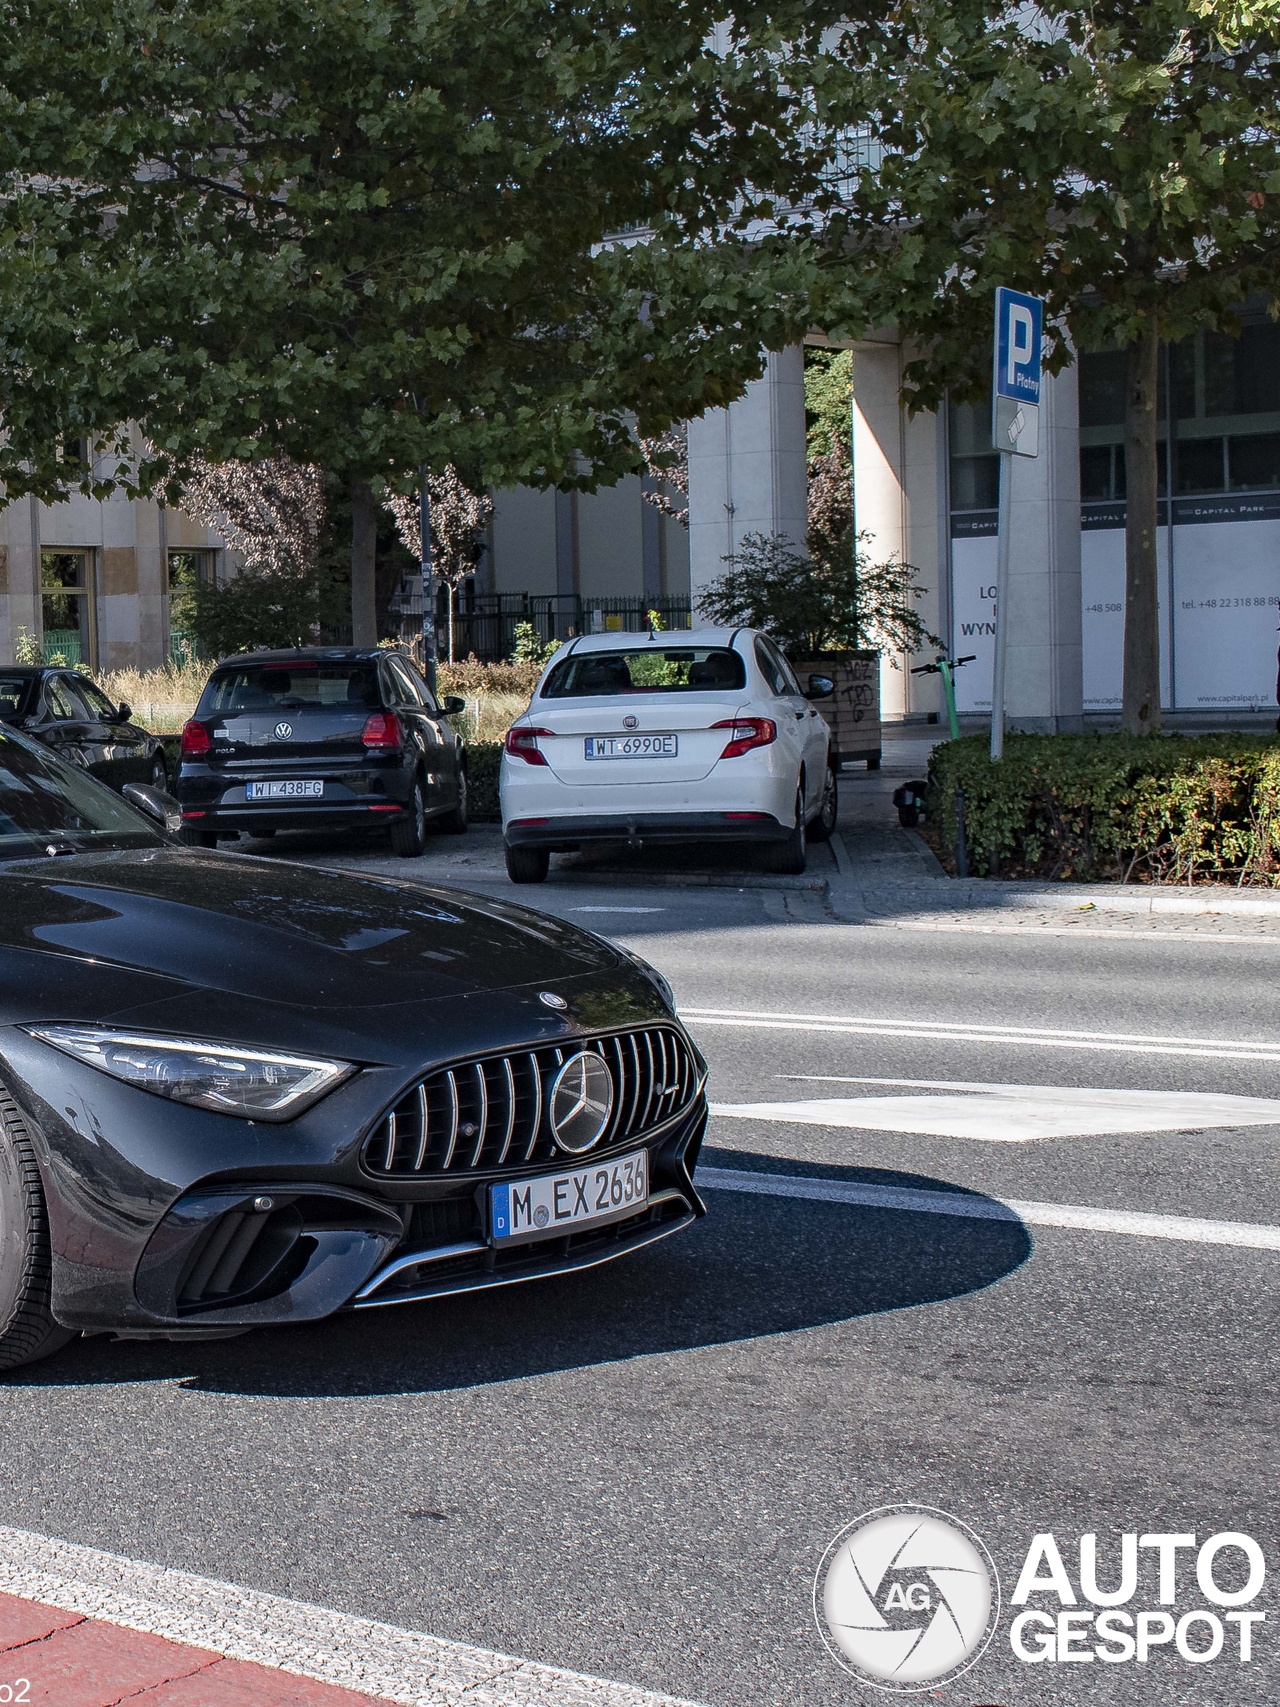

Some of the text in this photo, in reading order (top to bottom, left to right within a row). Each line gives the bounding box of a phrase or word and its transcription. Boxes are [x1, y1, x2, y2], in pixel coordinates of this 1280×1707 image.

[1007, 303, 1033, 384] P
[1016, 372, 1039, 396] Płatny
[1194, 507, 1236, 515] CAPITAL
[1239, 505, 1265, 513] PARK
[1080, 514, 1119, 522] CAPITAL
[1086, 603, 1122, 613] +48 508
[1182, 599, 1196, 609] tel.
[1198, 599, 1217, 608] +48
[1220, 598, 1231, 608] 22
[1234, 598, 1251, 607] 318
[1253, 597, 1266, 606] 88
[1197, 694, 1269, 703] www.capitalpark.pl
[596, 740, 616, 754] WT
[623, 737, 673, 754] 6990E
[255, 782, 322, 796] WI 438FG
[497, 1158, 644, 1229] D M EX 2636
